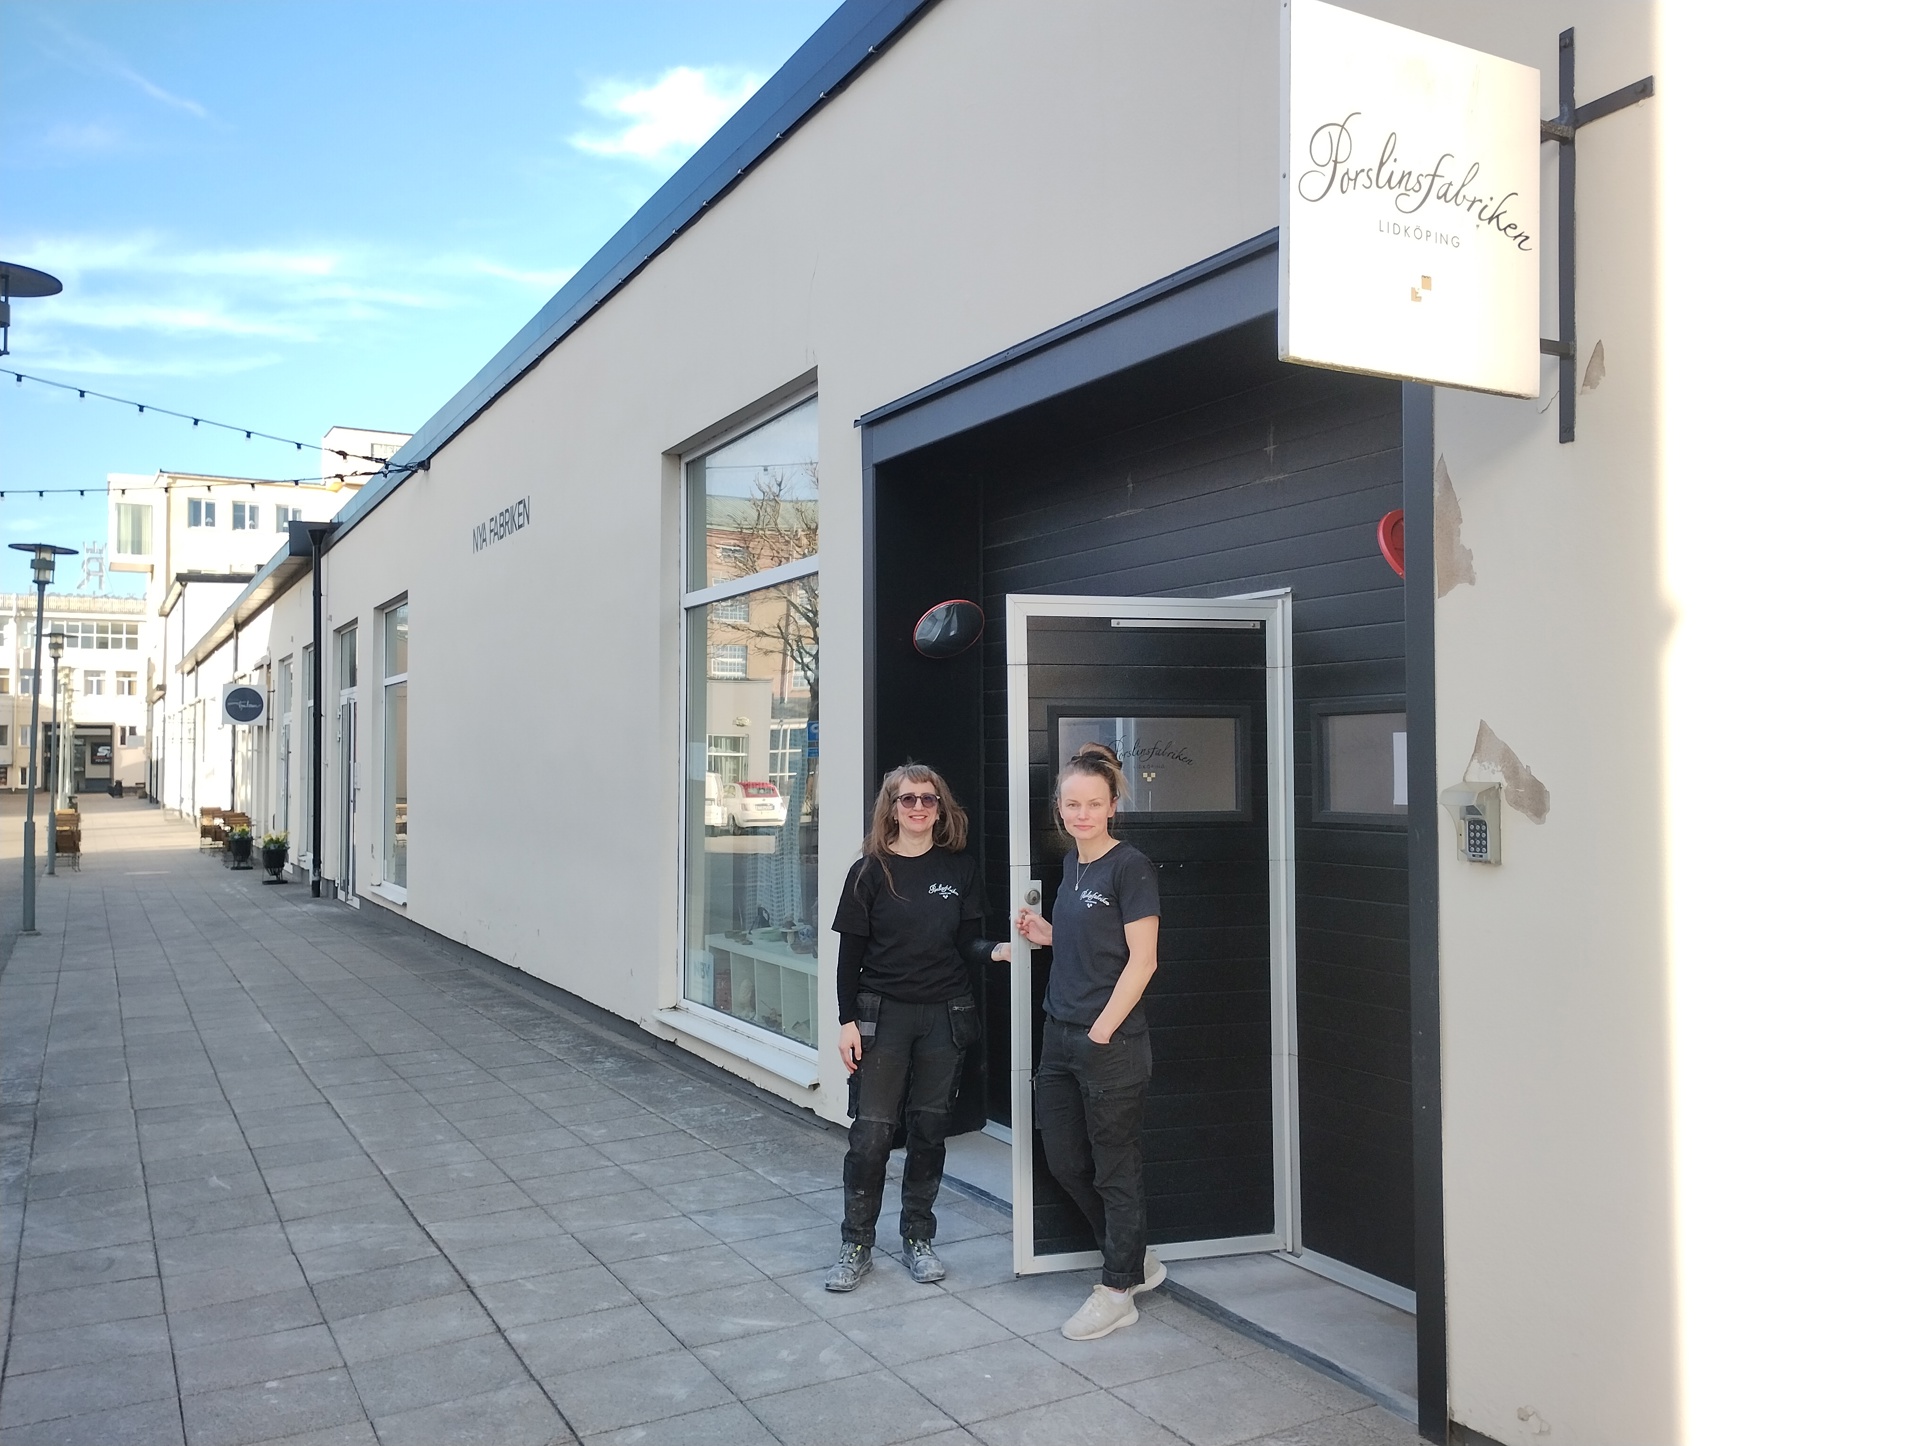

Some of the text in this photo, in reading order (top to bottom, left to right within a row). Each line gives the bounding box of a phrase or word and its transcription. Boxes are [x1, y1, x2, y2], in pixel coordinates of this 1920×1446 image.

[1298, 111, 1533, 252] Porslinsfabriken
[1378, 219, 1461, 249] LIDKÖPING
[472, 495, 531, 555] NYA FABRIKEN
